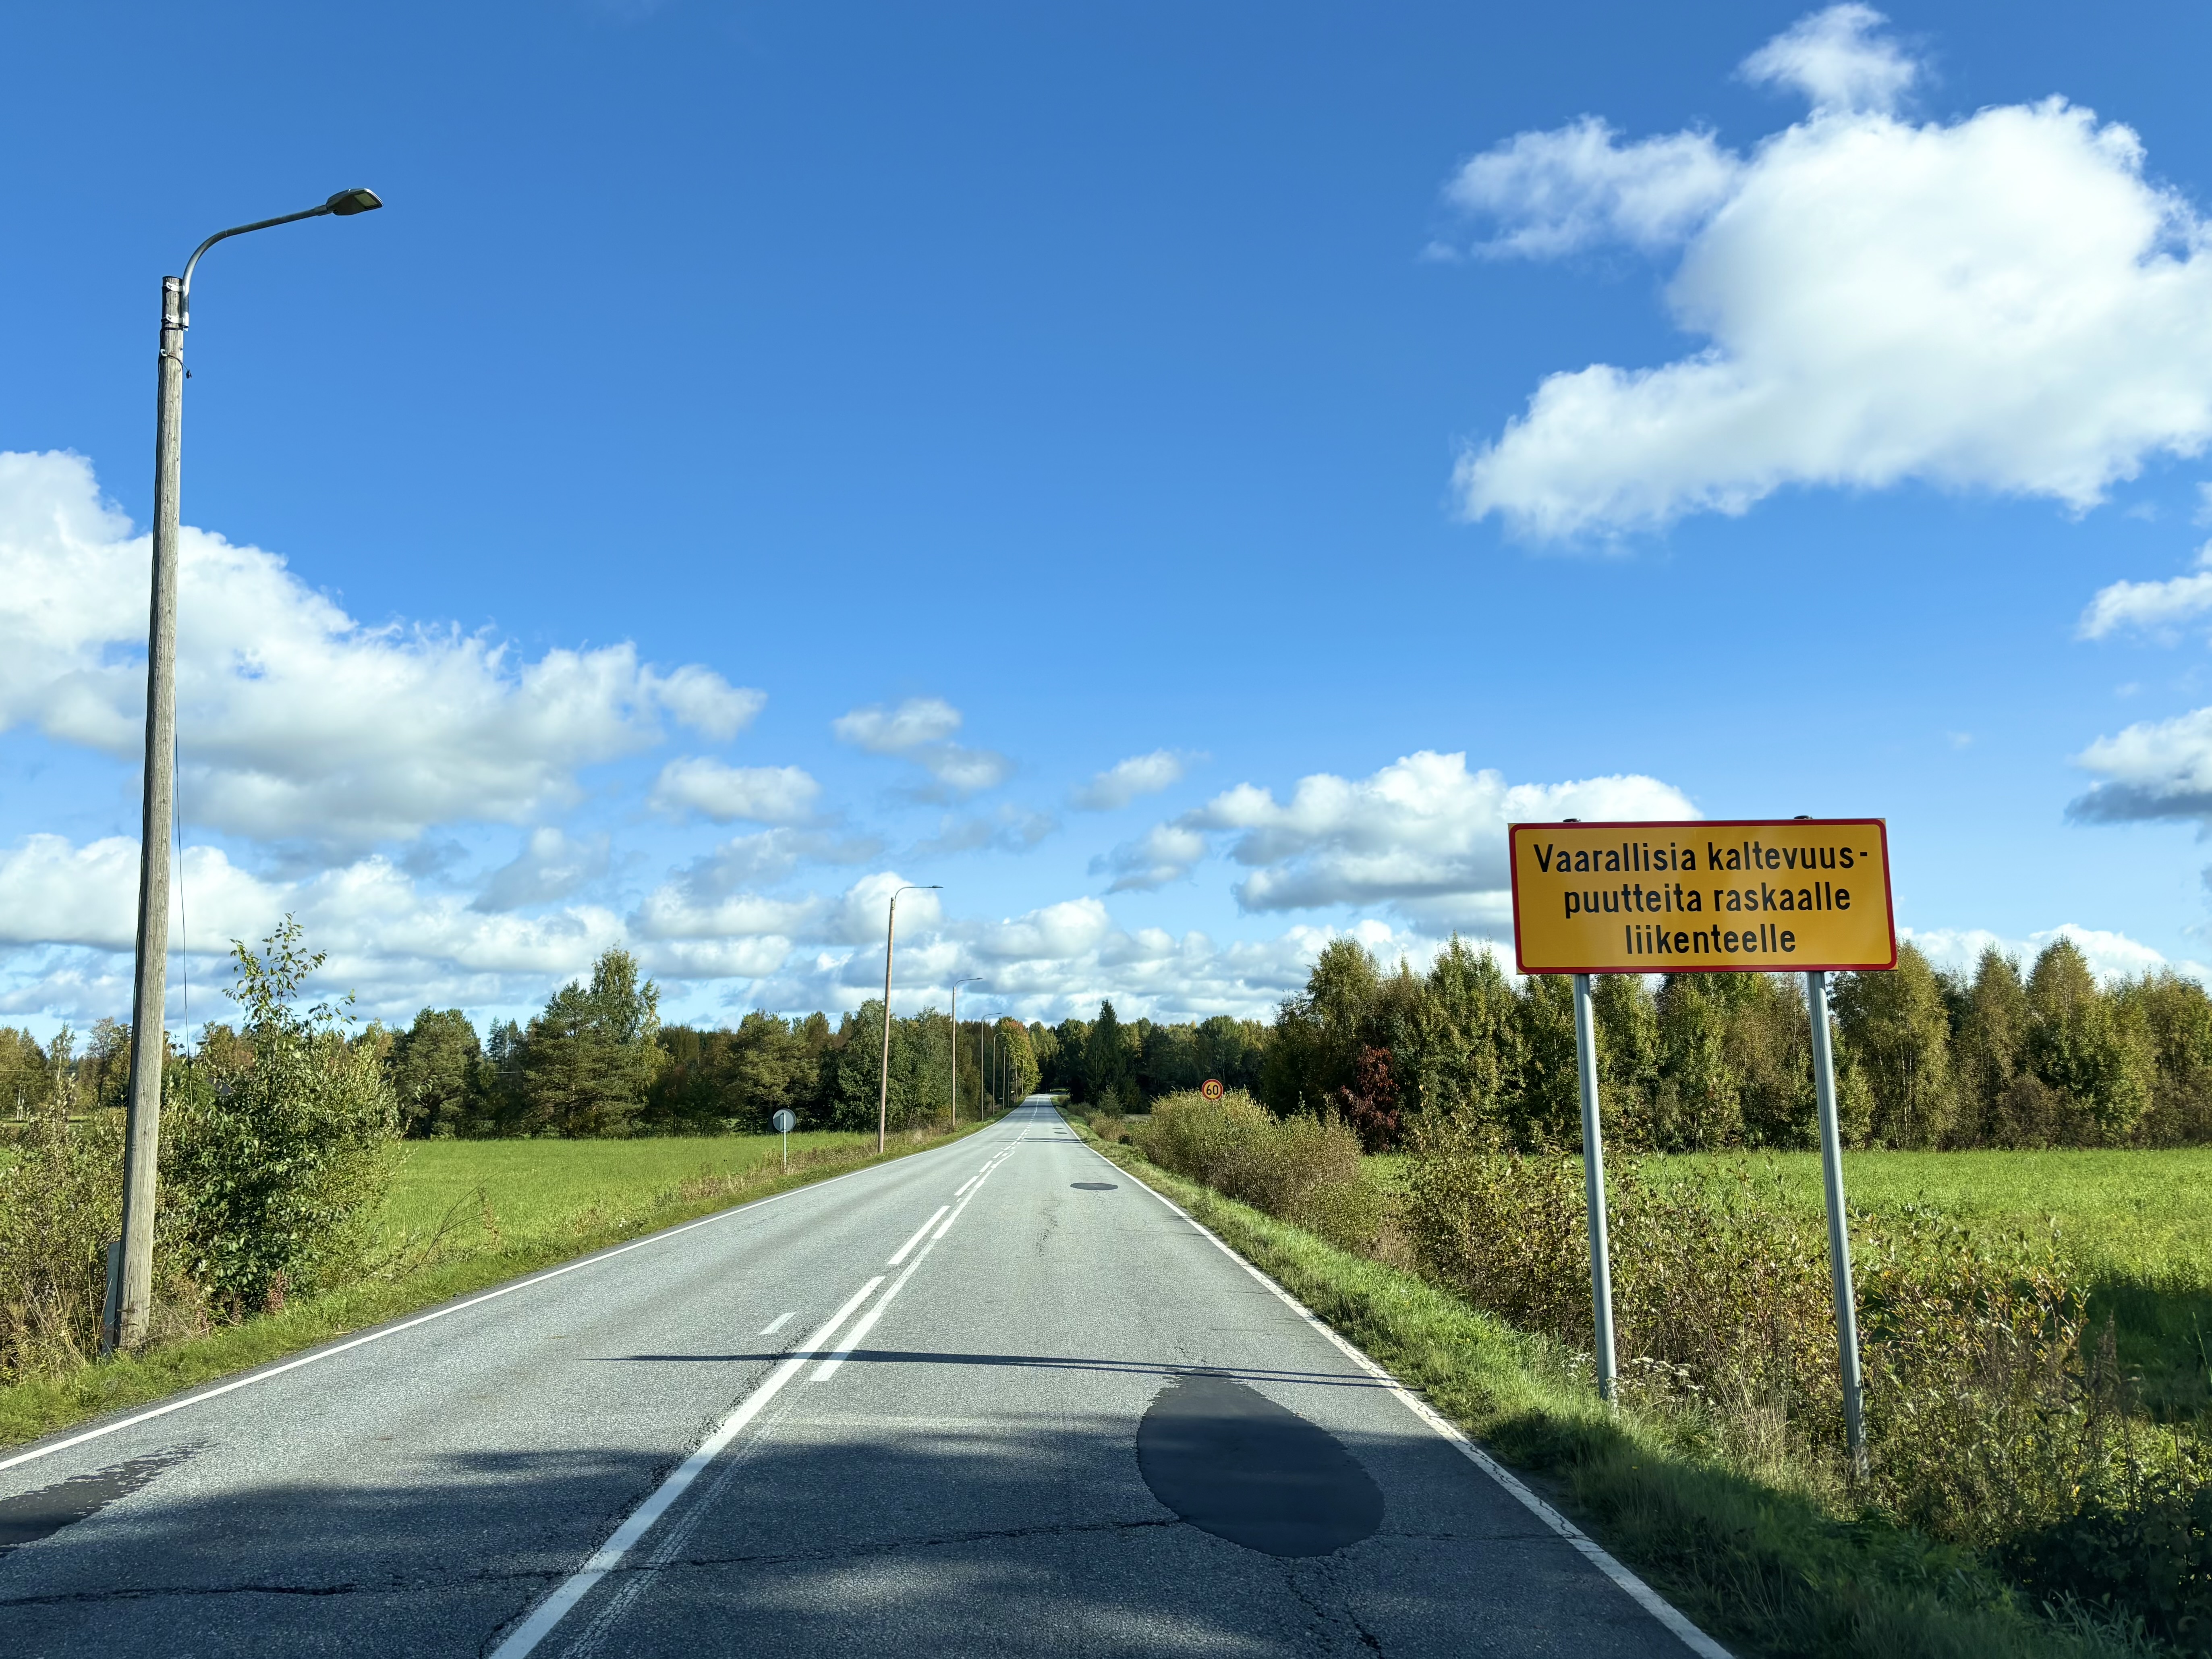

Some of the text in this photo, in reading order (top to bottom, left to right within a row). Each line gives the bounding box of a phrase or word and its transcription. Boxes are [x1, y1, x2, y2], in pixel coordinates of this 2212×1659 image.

[1533, 841, 1868, 873] Vaarallisia kaltevuus-
[1564, 881, 1850, 919] puutteita raskaalle
[1625, 923, 1795, 954] liikenteelle
[1207, 1085, 1219, 1095] 60
